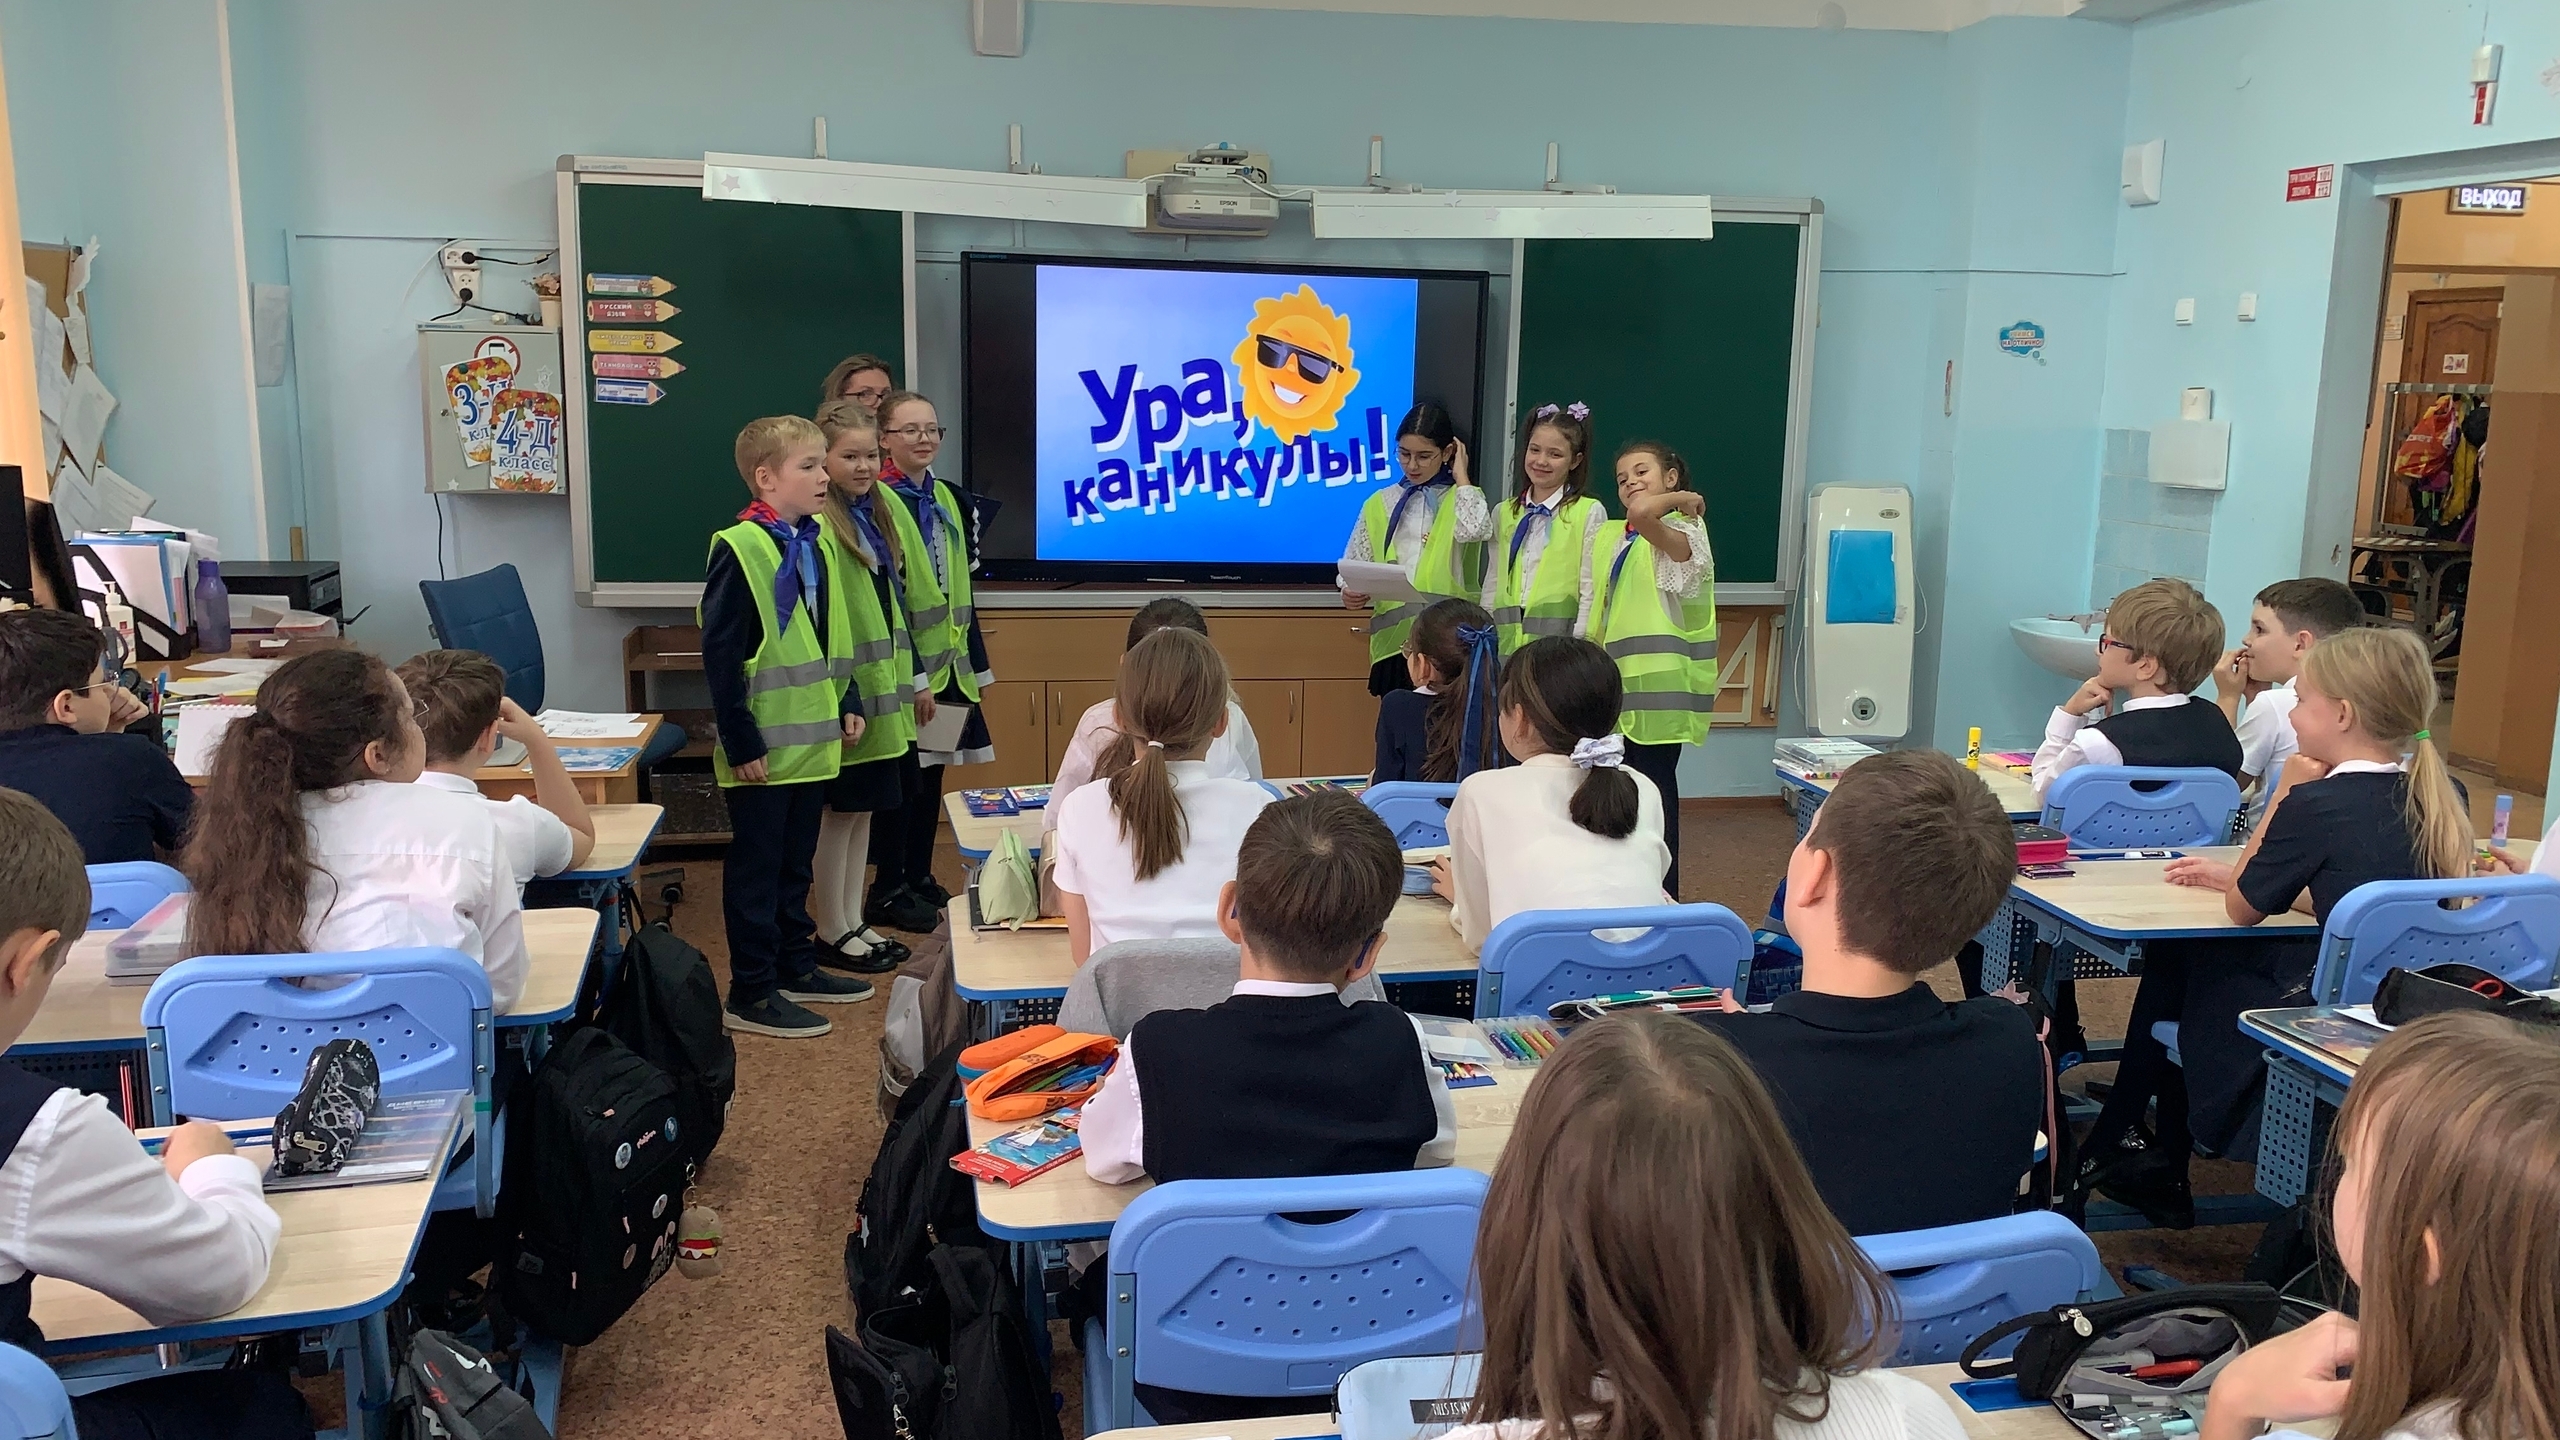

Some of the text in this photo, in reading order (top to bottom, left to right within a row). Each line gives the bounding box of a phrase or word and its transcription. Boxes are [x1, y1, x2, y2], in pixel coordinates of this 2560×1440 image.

[2319, 170, 2331, 181] 101
[2318, 186, 2329, 196] 112
[2461, 187, 2522, 207] ВЫХОД
[599, 302, 632, 310] РУССКИЙ
[1078, 358, 1252, 468] Ура,
[496, 408, 554, 457] 4-Д
[499, 457, 552, 472] класс
[1064, 407, 1392, 526] каникулы!
[1449, 1401, 1460, 1415] IS
